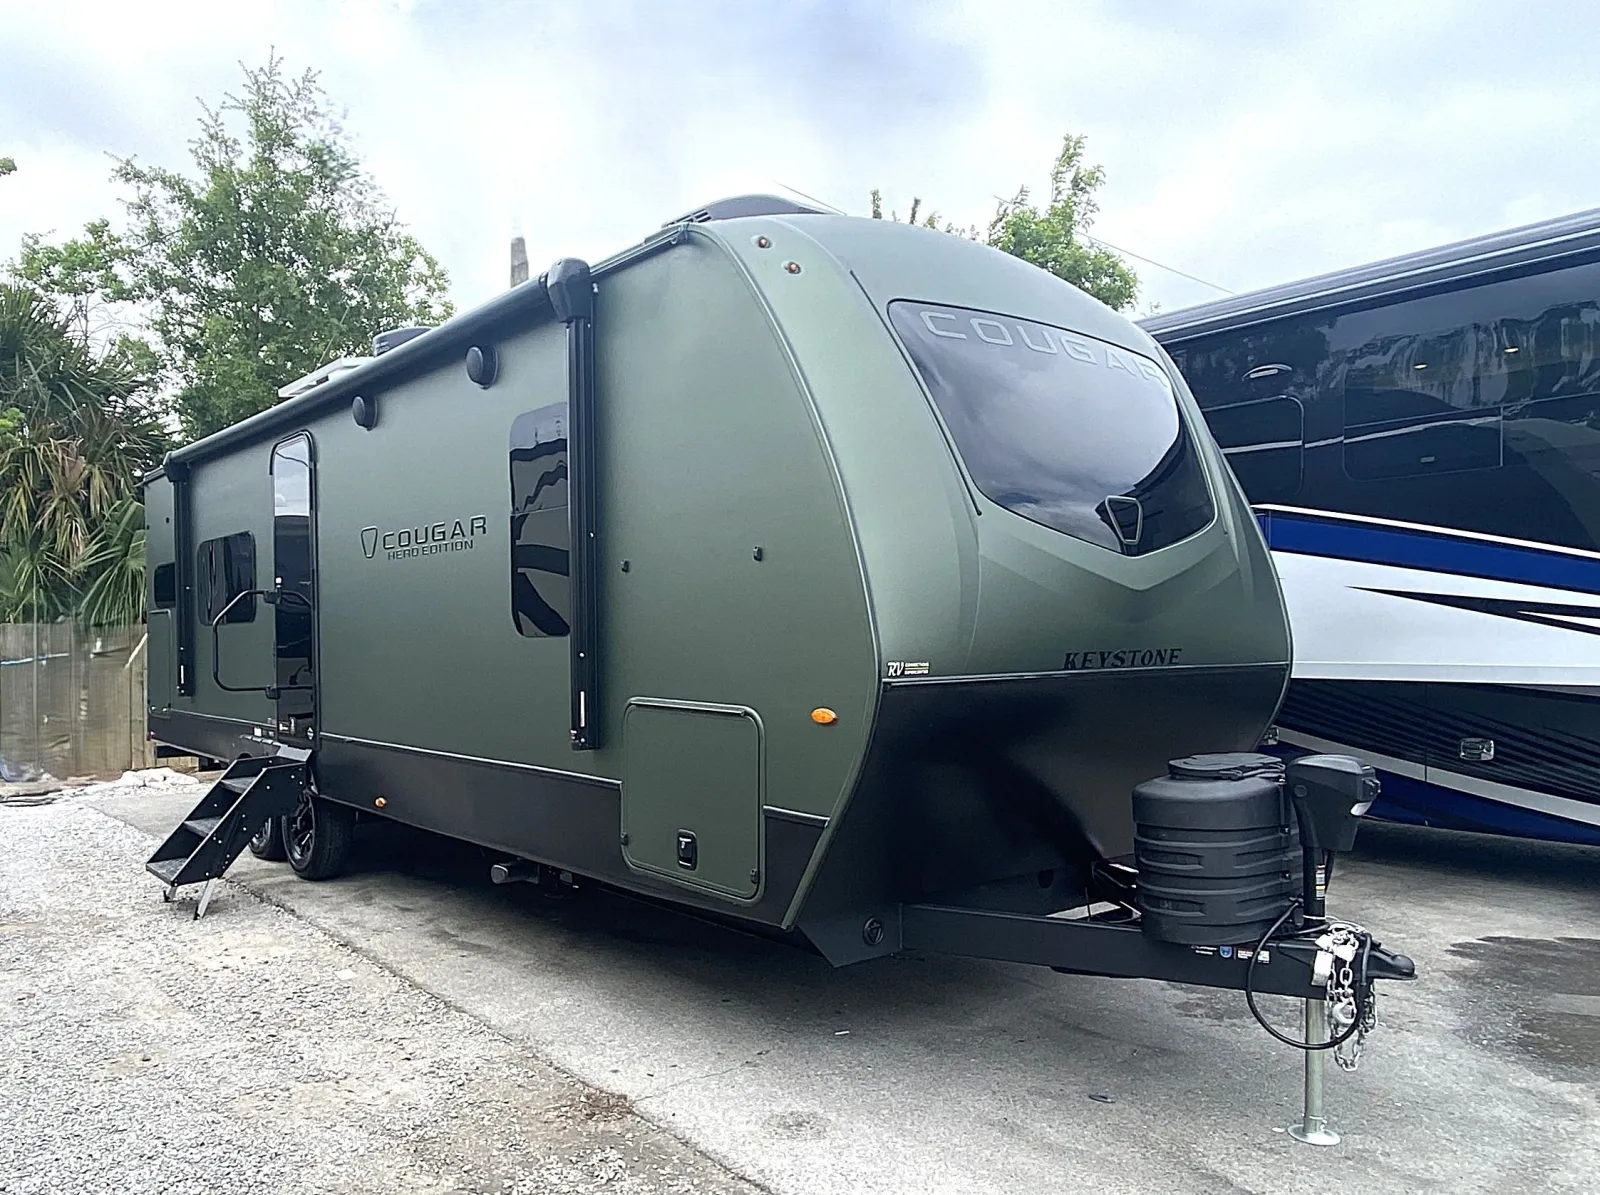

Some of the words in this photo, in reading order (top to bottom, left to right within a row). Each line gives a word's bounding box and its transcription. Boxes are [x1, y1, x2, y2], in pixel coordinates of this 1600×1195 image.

[919, 310, 1168, 388] COUGAR
[382, 515, 487, 550] COUGAR
[422, 540, 473, 555] EDITION
[887, 661, 904, 677] RV
[1061, 648, 1182, 670] KEYSTONE
